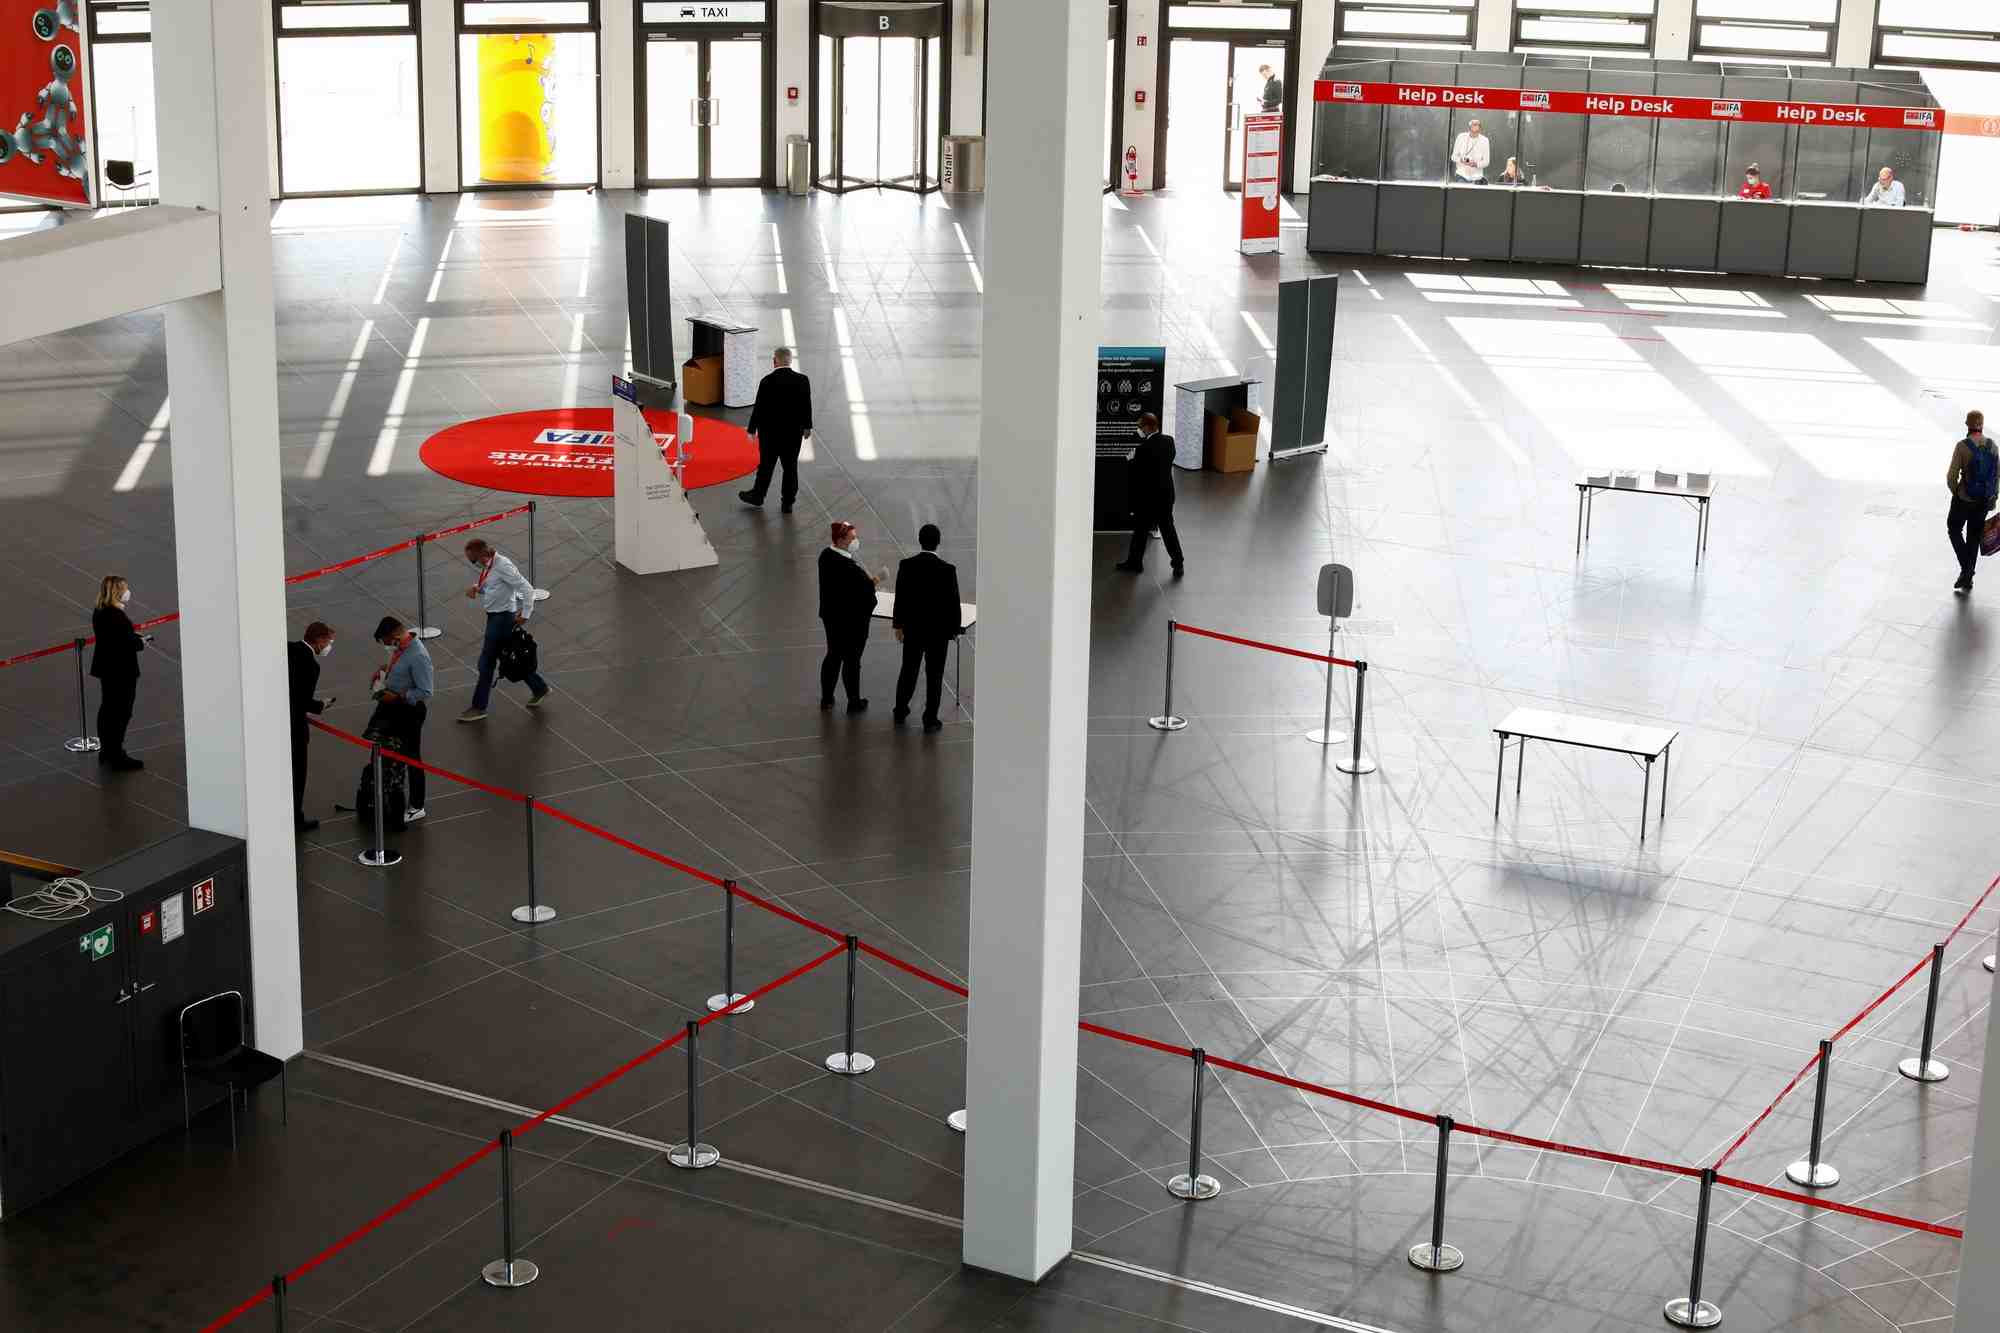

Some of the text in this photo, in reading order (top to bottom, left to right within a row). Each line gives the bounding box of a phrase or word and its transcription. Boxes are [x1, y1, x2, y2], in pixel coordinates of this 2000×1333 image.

[700, 7, 728, 17] TAXI
[879, 15, 890, 30] B
[1398, 88, 1485, 105] Help Desk
[1586, 96, 1673, 114] Help Desk
[1777, 105, 1866, 123] Help Desk
[944, 153, 953, 184] Abfall
[546, 431, 603, 444] IFA
[487, 451, 614, 465] FUTURE
